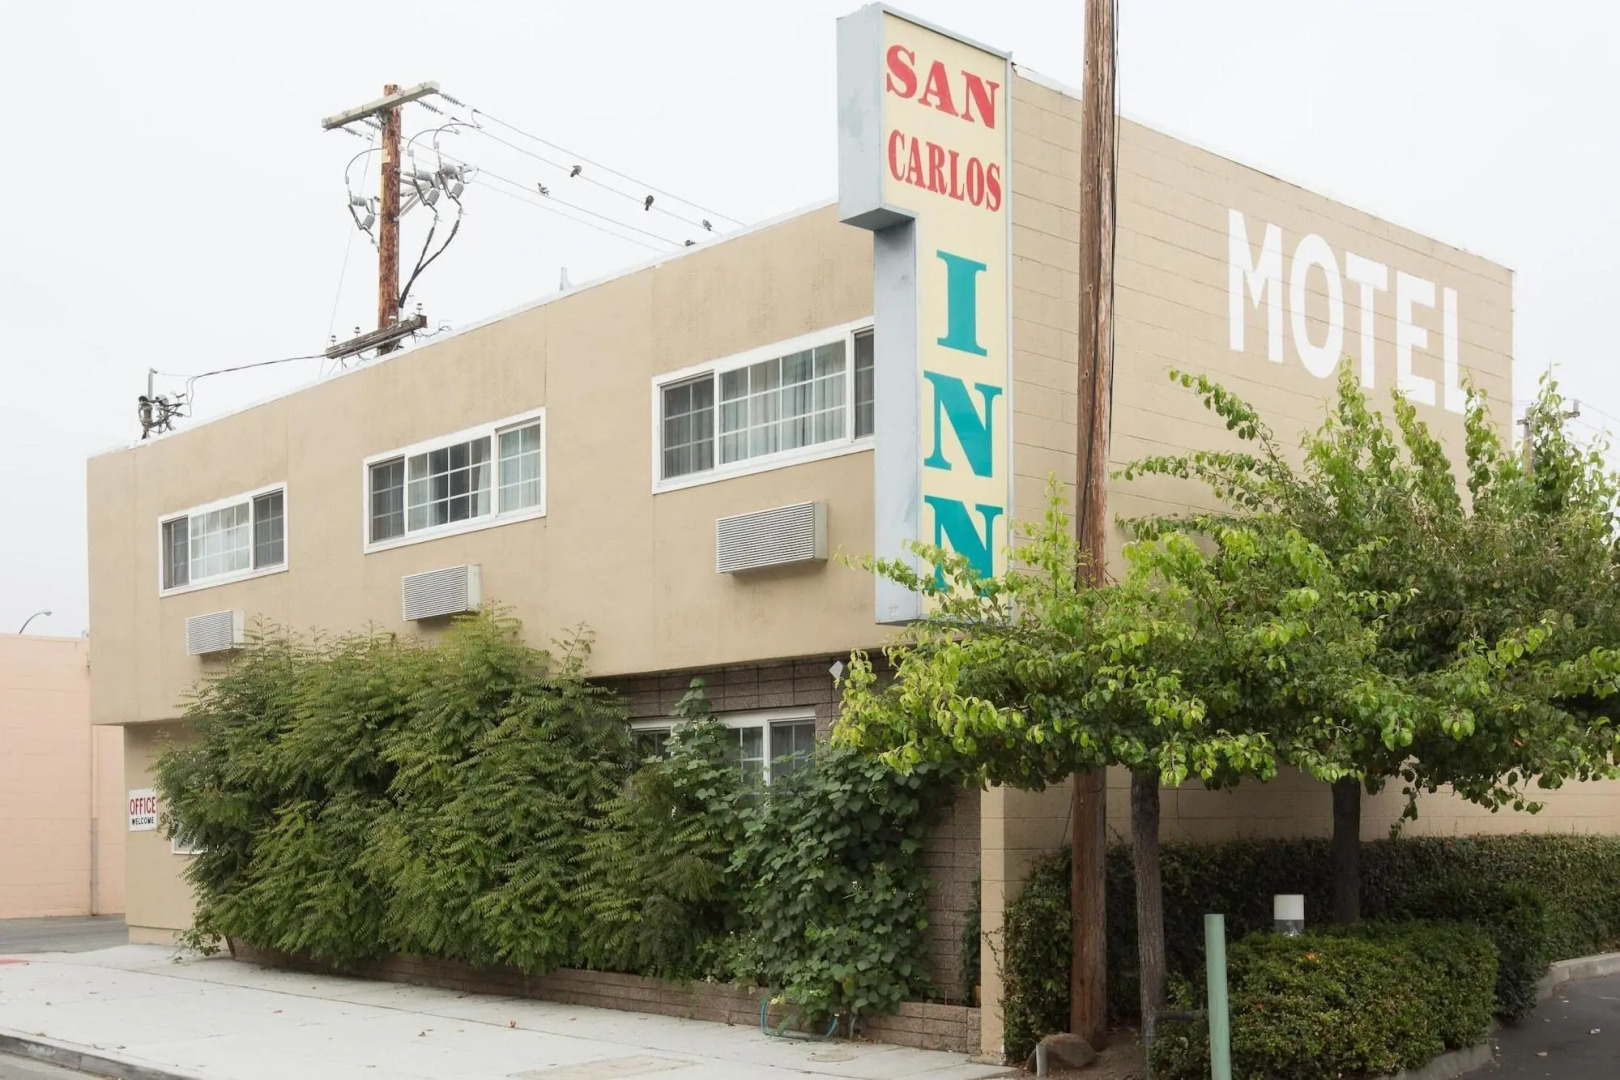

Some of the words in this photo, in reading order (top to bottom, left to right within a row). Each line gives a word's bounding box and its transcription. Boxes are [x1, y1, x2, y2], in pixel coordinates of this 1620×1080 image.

[886, 45, 1000, 129] SAN
[888, 129, 1002, 212] CARLOS
[1228, 208, 1481, 418] MOTEL
[923, 249, 1003, 598] INN
[129, 796, 156, 815] OFFICE
[131, 817, 154, 825] WELCOME
